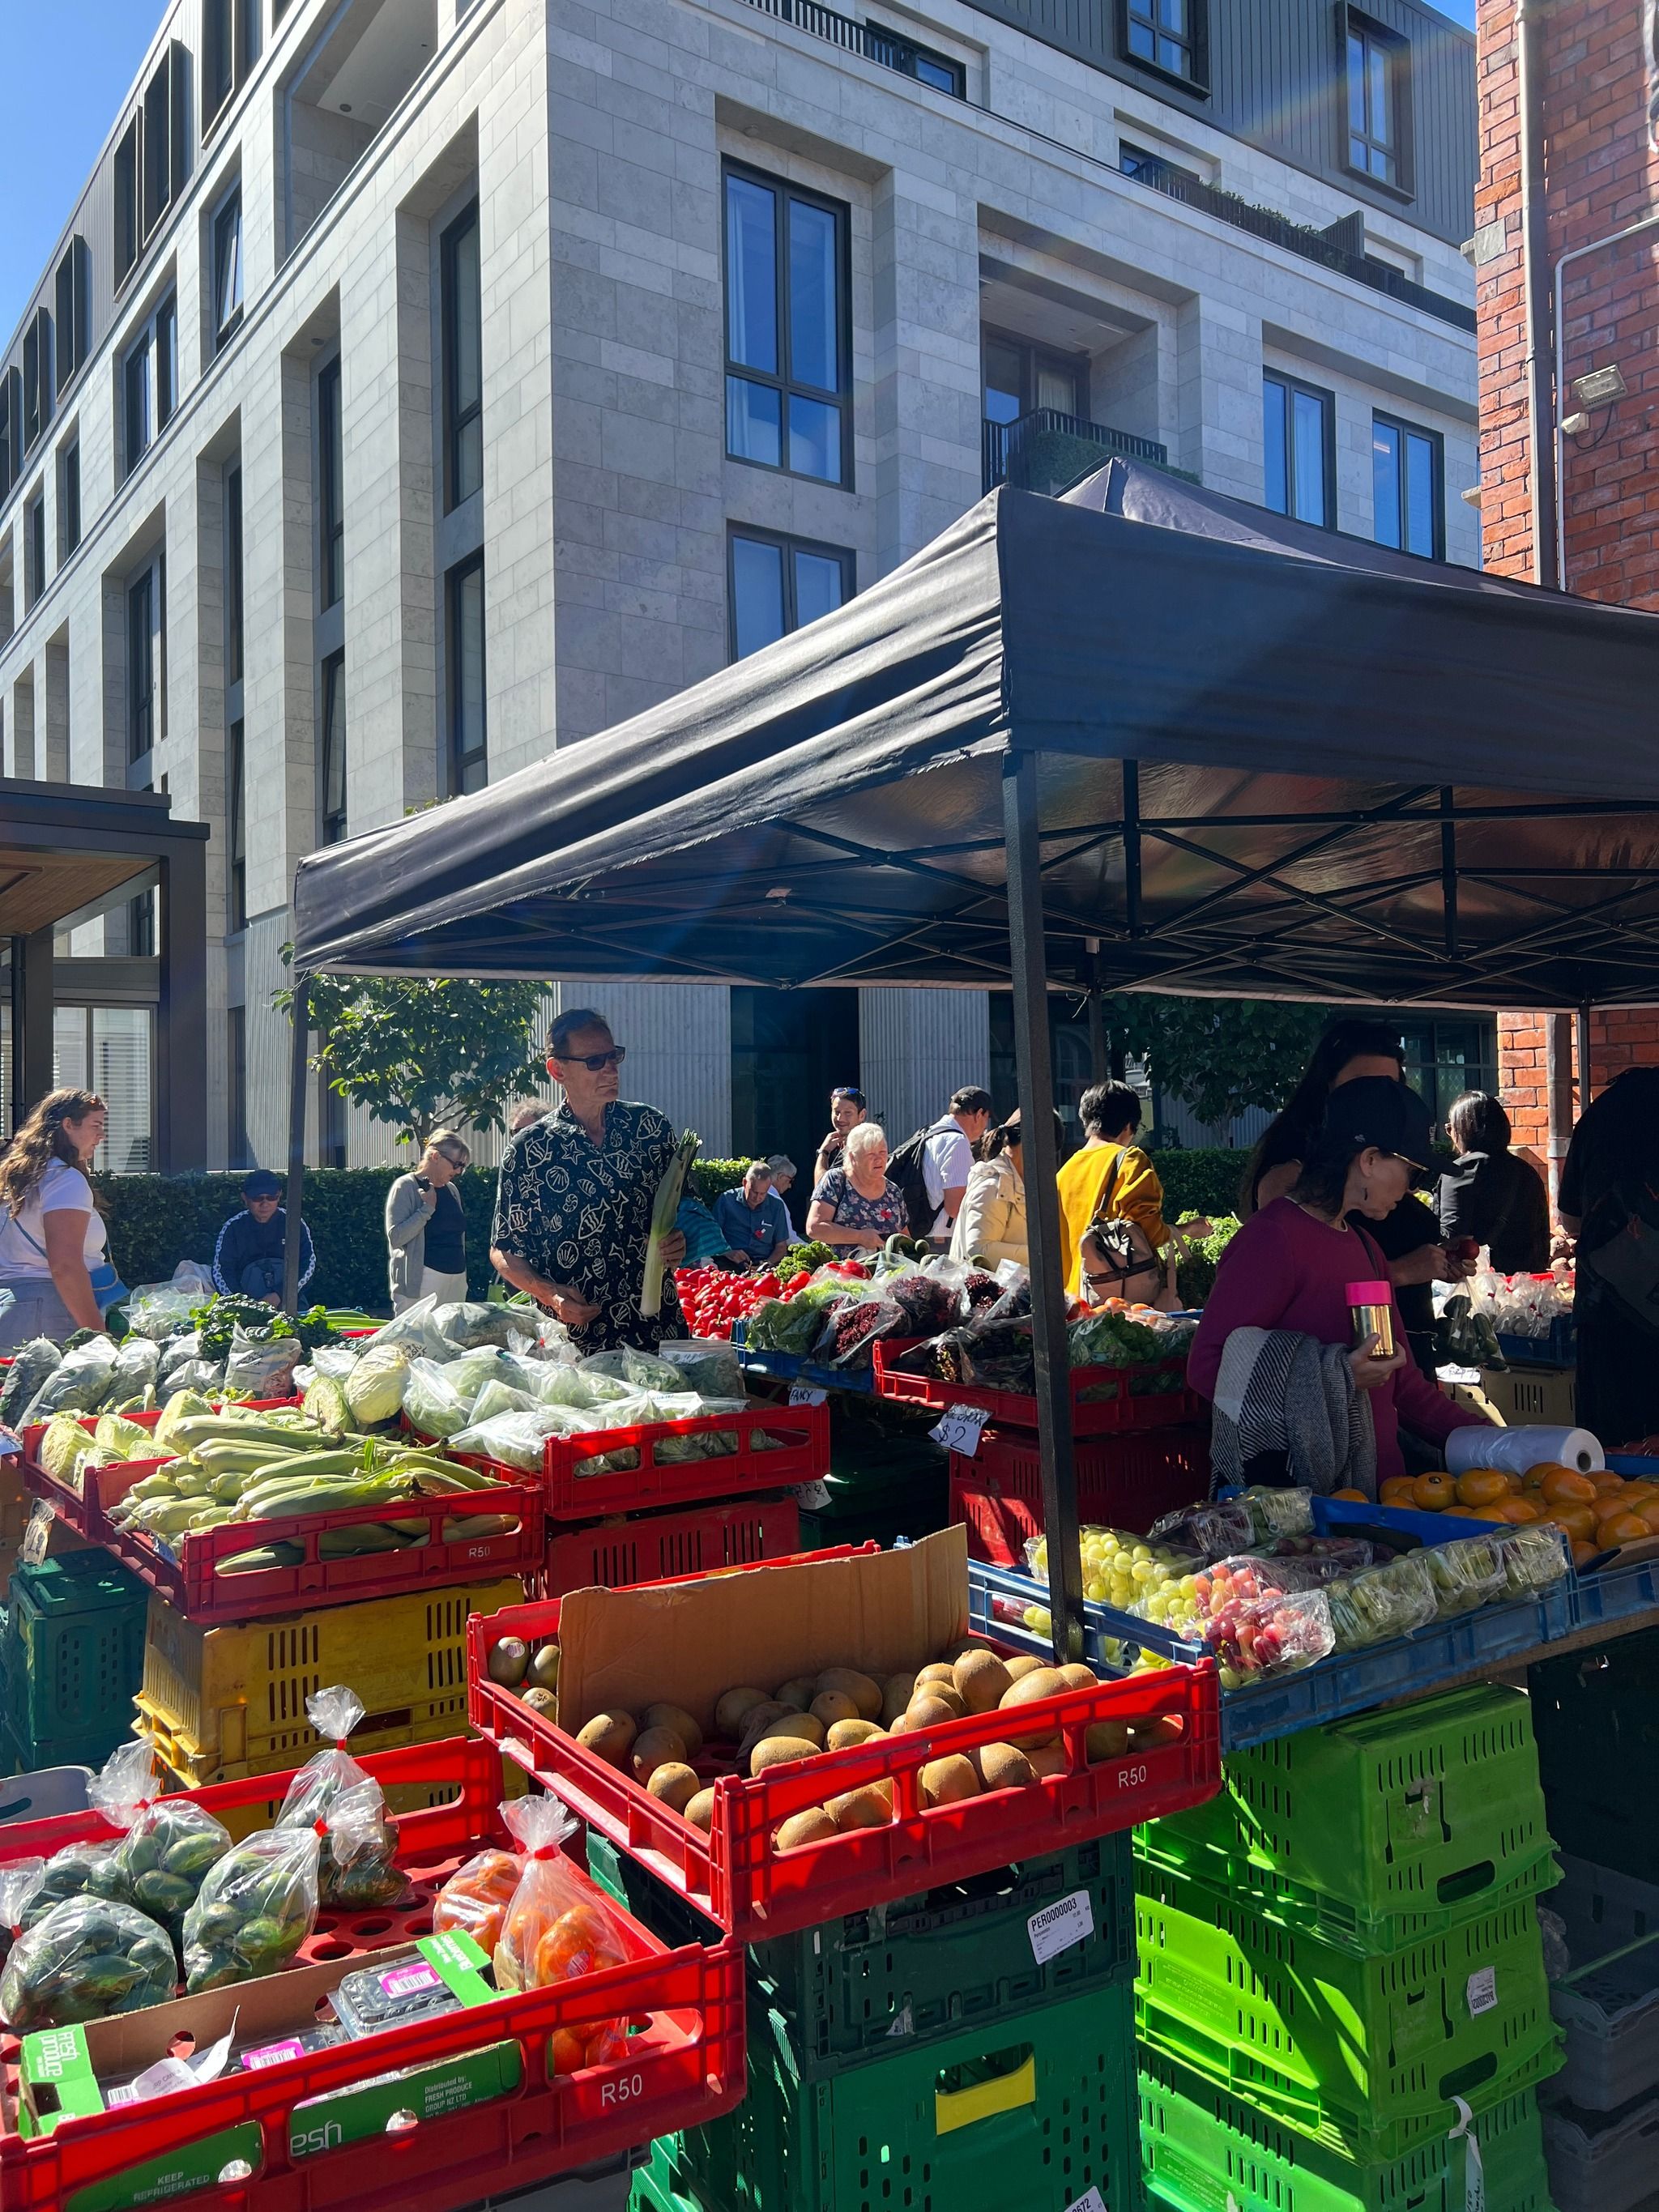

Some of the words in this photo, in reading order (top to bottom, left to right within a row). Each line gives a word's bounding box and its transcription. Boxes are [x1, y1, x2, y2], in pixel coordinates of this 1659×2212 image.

[790, 1387, 813, 1402] FANCY
[938, 1423, 967, 1452] $2
[469, 1545, 491, 1559] R50
[1118, 1765, 1146, 1788] R50
[424, 2091, 444, 2103] FRESH
[446, 2082, 473, 2095] PRODUCE
[425, 2077, 457, 2094] Distributed
[601, 2073, 642, 2107] R50
[425, 2100, 445, 2112] GROUP
[446, 2096, 454, 2106] NZ
[456, 2094, 467, 2103] LTD
[133, 2174, 210, 2202] REFRIGERATED
[157, 2171, 184, 2186] KEEP
